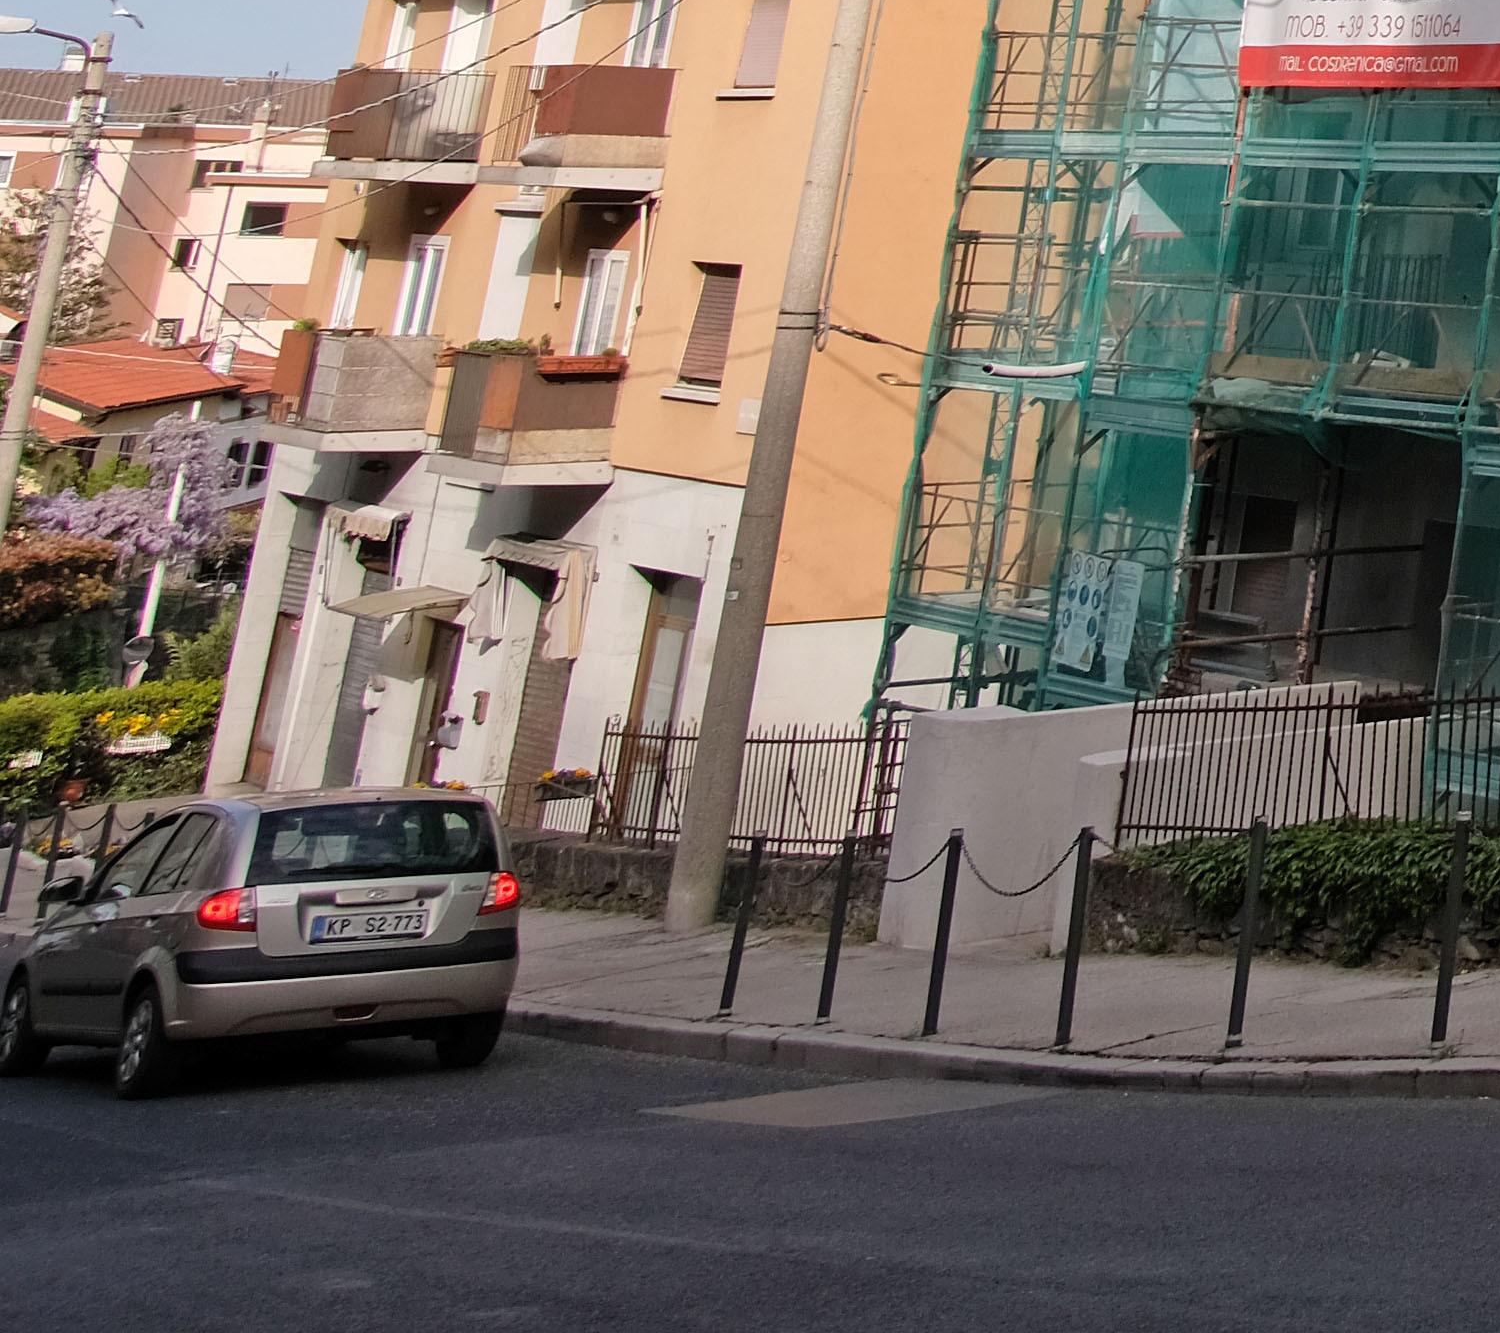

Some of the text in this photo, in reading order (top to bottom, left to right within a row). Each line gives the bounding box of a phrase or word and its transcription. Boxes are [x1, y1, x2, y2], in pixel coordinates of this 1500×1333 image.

[1337, 16, 1364, 38] +39
[1367, 15, 1405, 38] 339
[1410, 14, 1462, 38] 1511064
[326, 913, 423, 935] KP S2-773
